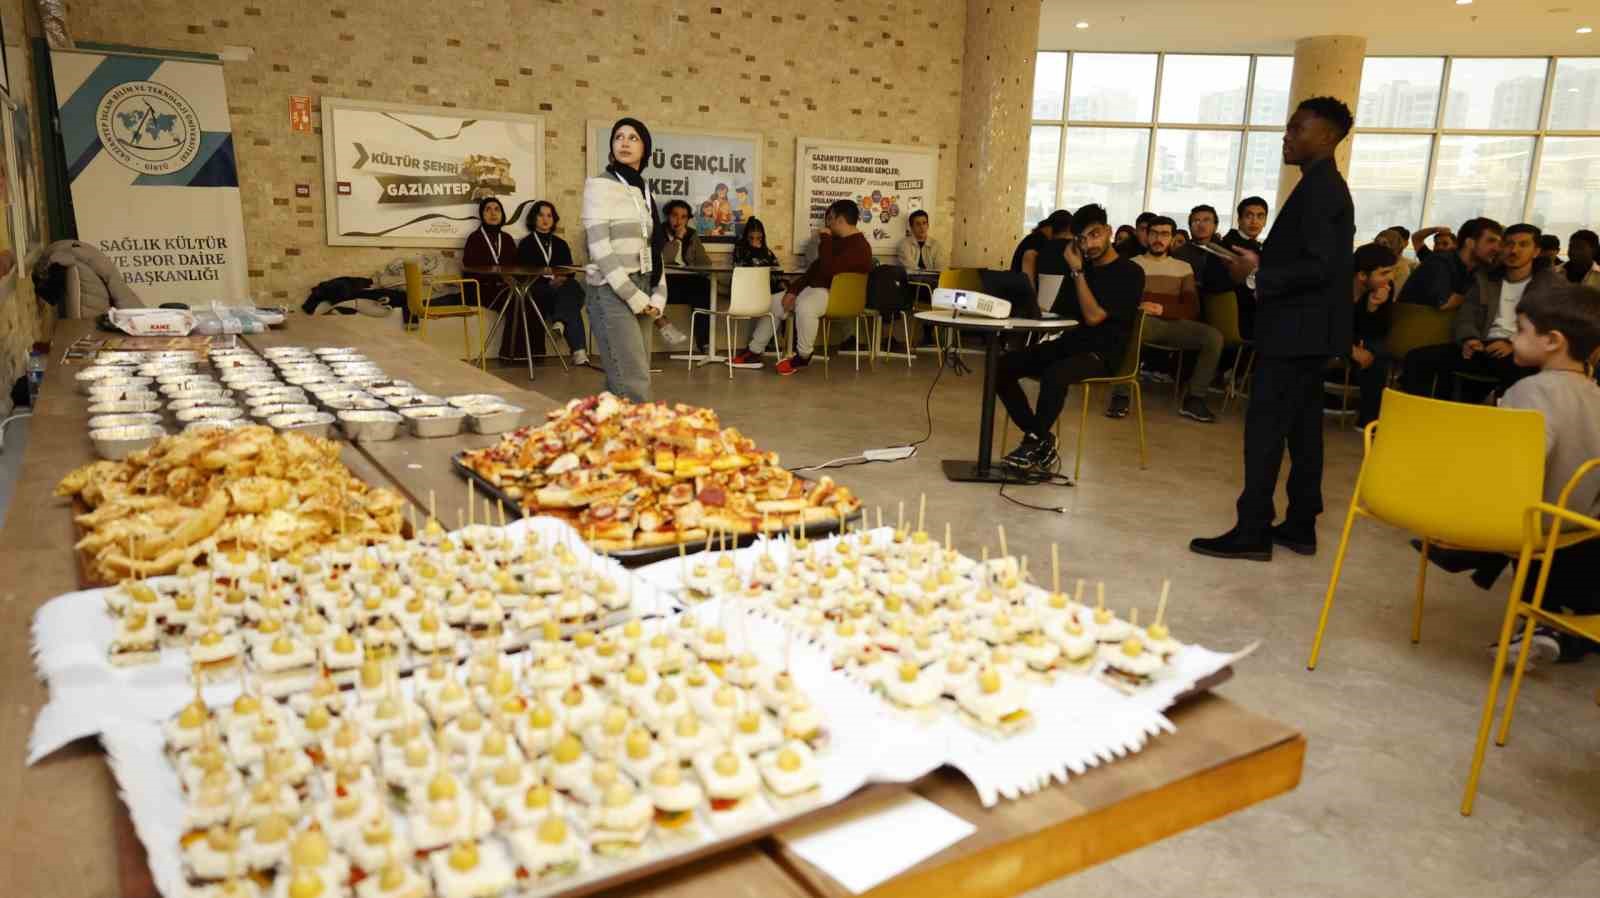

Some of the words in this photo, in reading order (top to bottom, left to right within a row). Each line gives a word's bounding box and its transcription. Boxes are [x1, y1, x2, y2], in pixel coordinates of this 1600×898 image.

[371, 151, 420, 169] KÜLTÜR
[422, 159, 459, 174] ŞEHRİ
[670, 153, 746, 174] GENÇLİK
[648, 177, 689, 196] KEZİ
[99, 236, 161, 251] SAĞLIK
[164, 235, 228, 250] KÜLTÜR
[132, 254, 175, 267] SPOR
[177, 251, 226, 266] DAİRE
[123, 267, 220, 285] BAŞKANLIĞI
